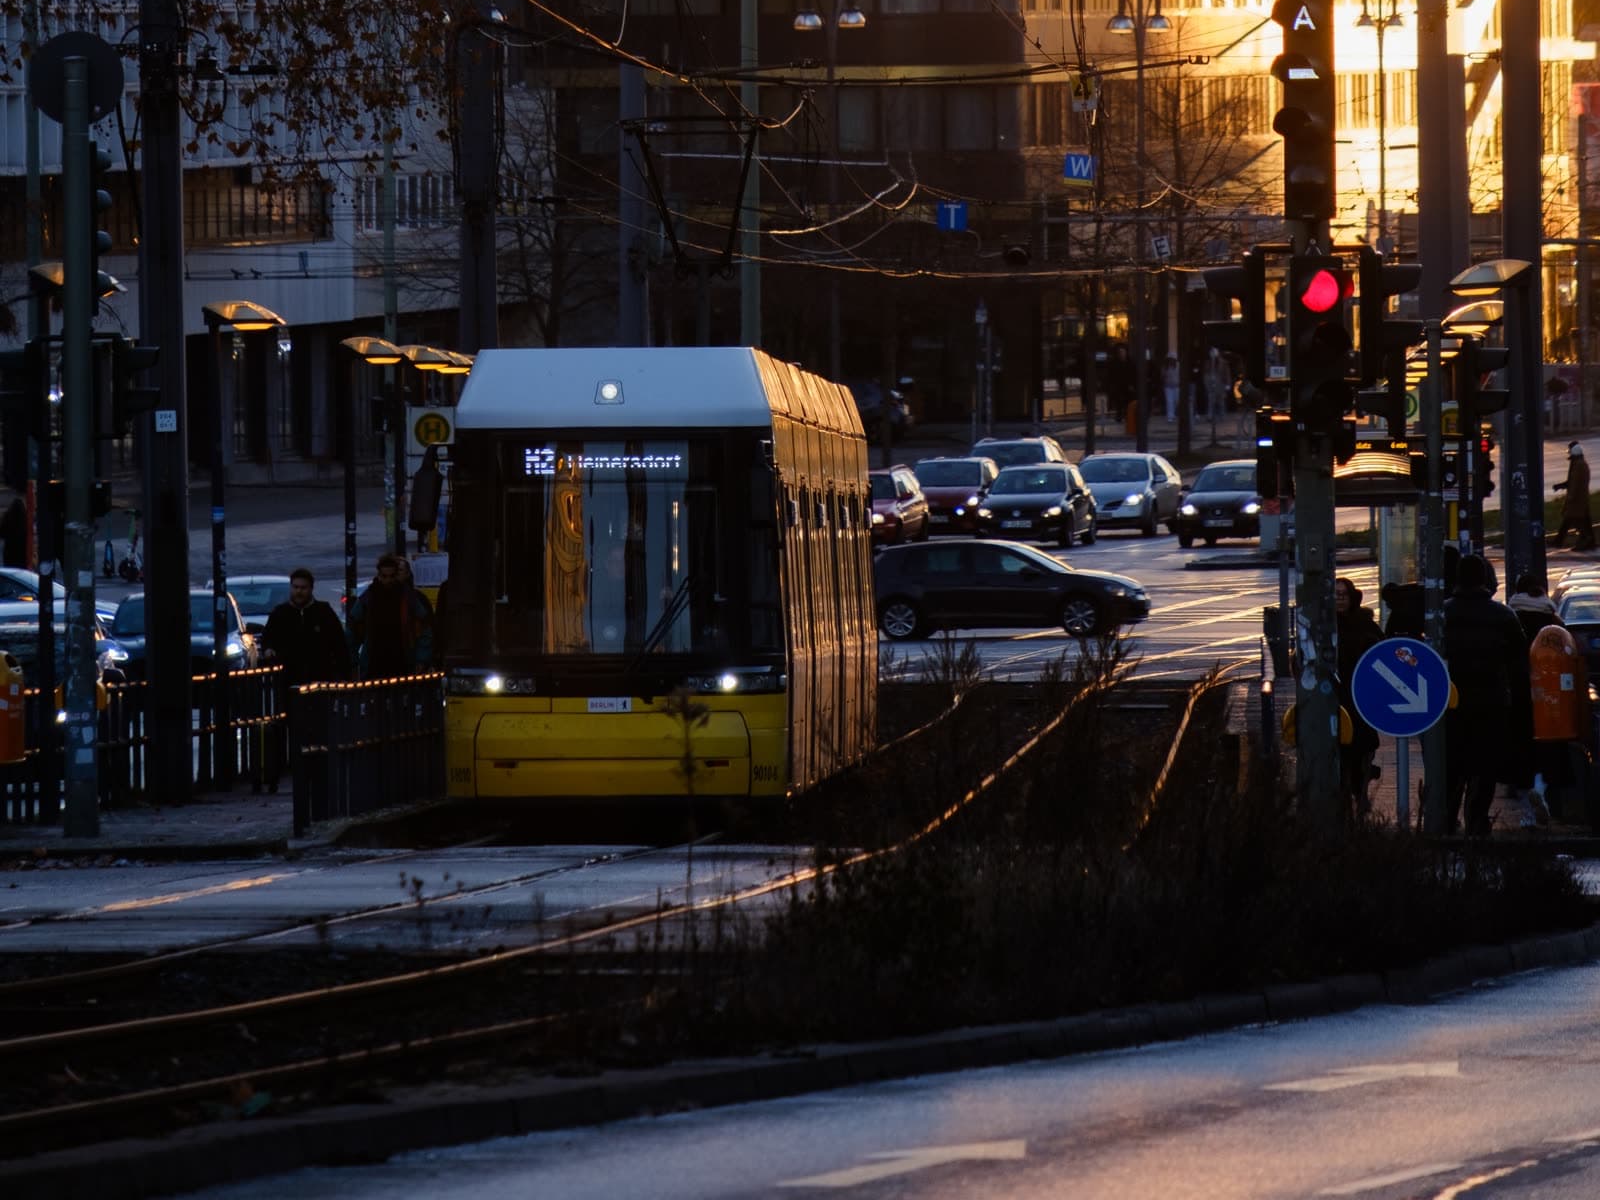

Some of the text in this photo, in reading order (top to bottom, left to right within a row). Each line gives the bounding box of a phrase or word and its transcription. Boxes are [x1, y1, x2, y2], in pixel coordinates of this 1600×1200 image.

[1293, 5, 1316, 31] A
[1071, 155, 1092, 177] W
[943, 203, 961, 229] T
[423, 421, 441, 441] H
